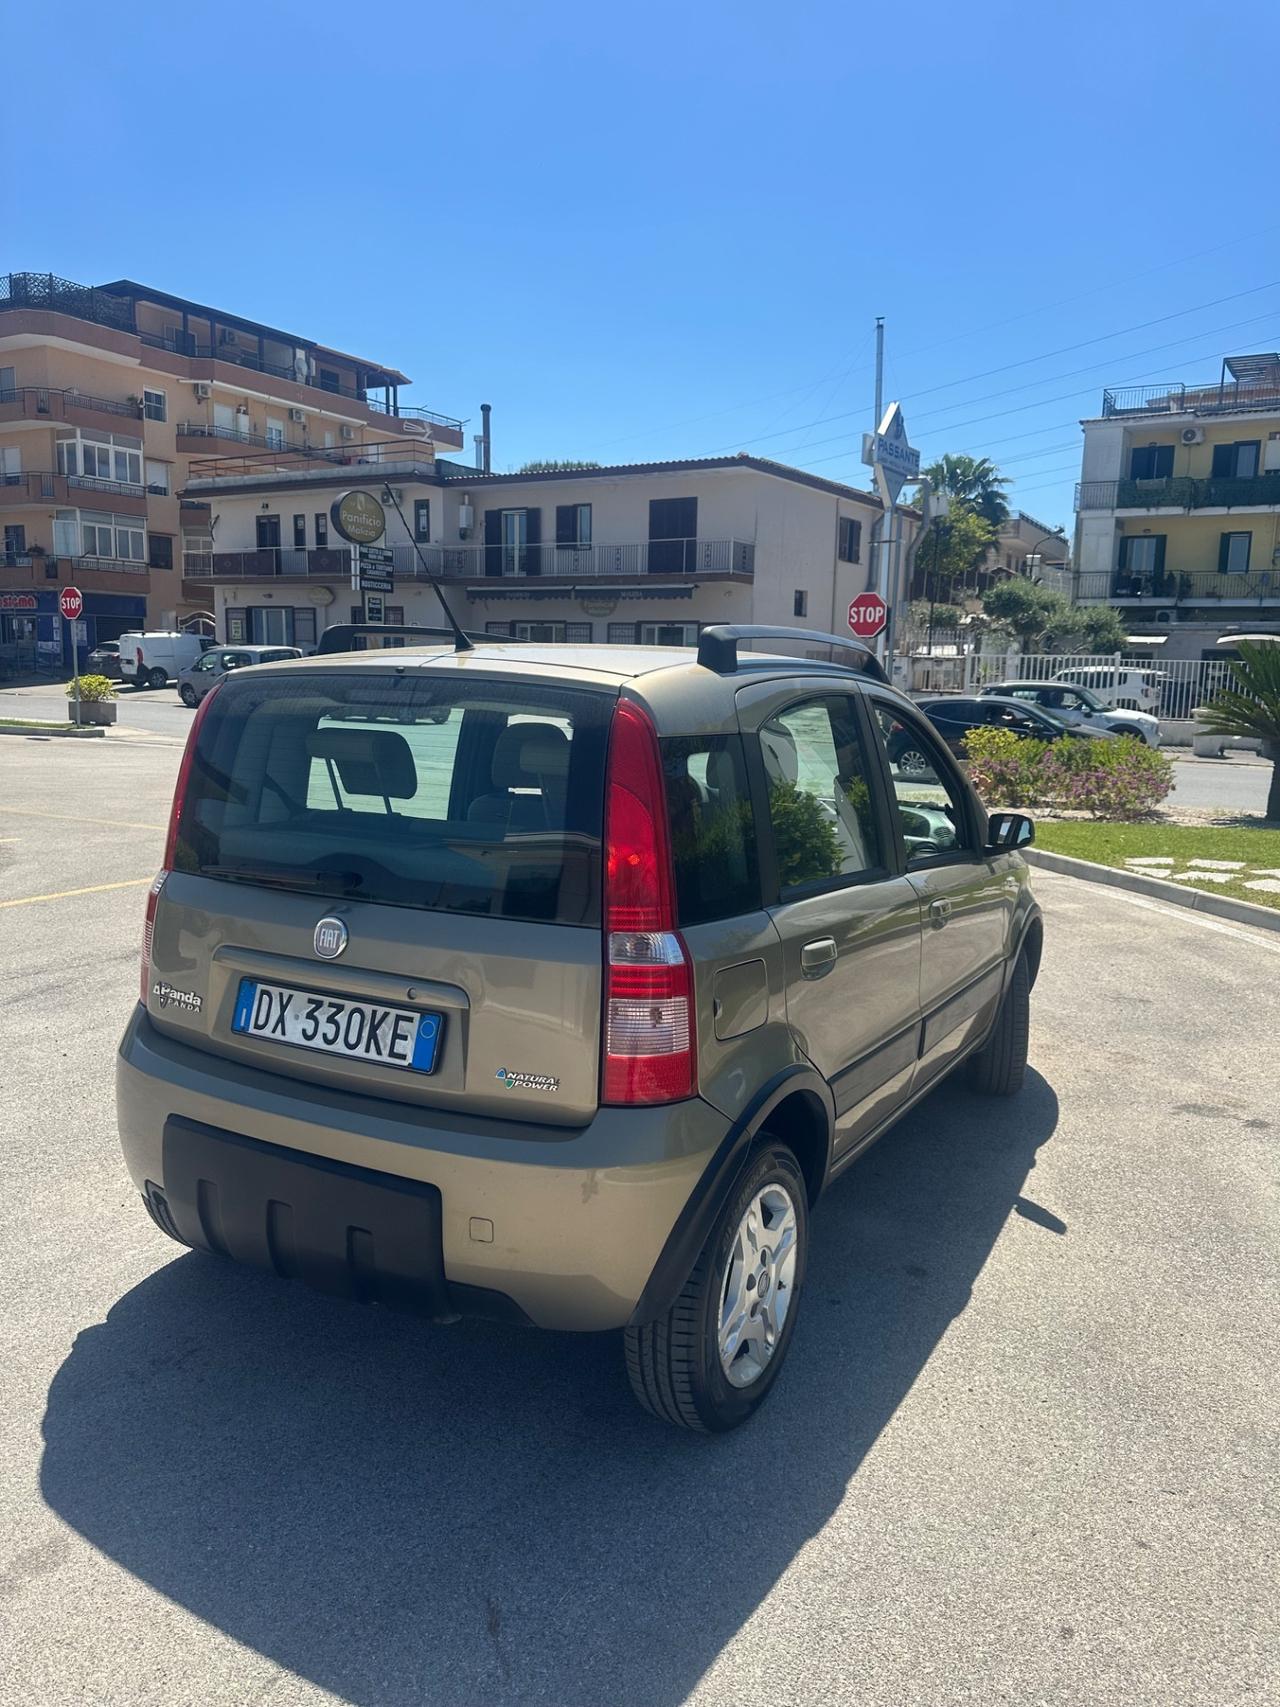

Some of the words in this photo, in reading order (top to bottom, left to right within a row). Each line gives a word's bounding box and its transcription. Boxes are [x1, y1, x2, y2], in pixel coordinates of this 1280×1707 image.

[342, 510, 381, 528] Panificio
[61, 597, 80, 609] STOP
[850, 606, 883, 624] STOP
[319, 928, 340, 948] FIAT
[168, 998, 200, 1013] PANDA
[253, 988, 293, 1036] DX
[301, 997, 415, 1061] 330KE
[511, 1080, 558, 1091] POWER
